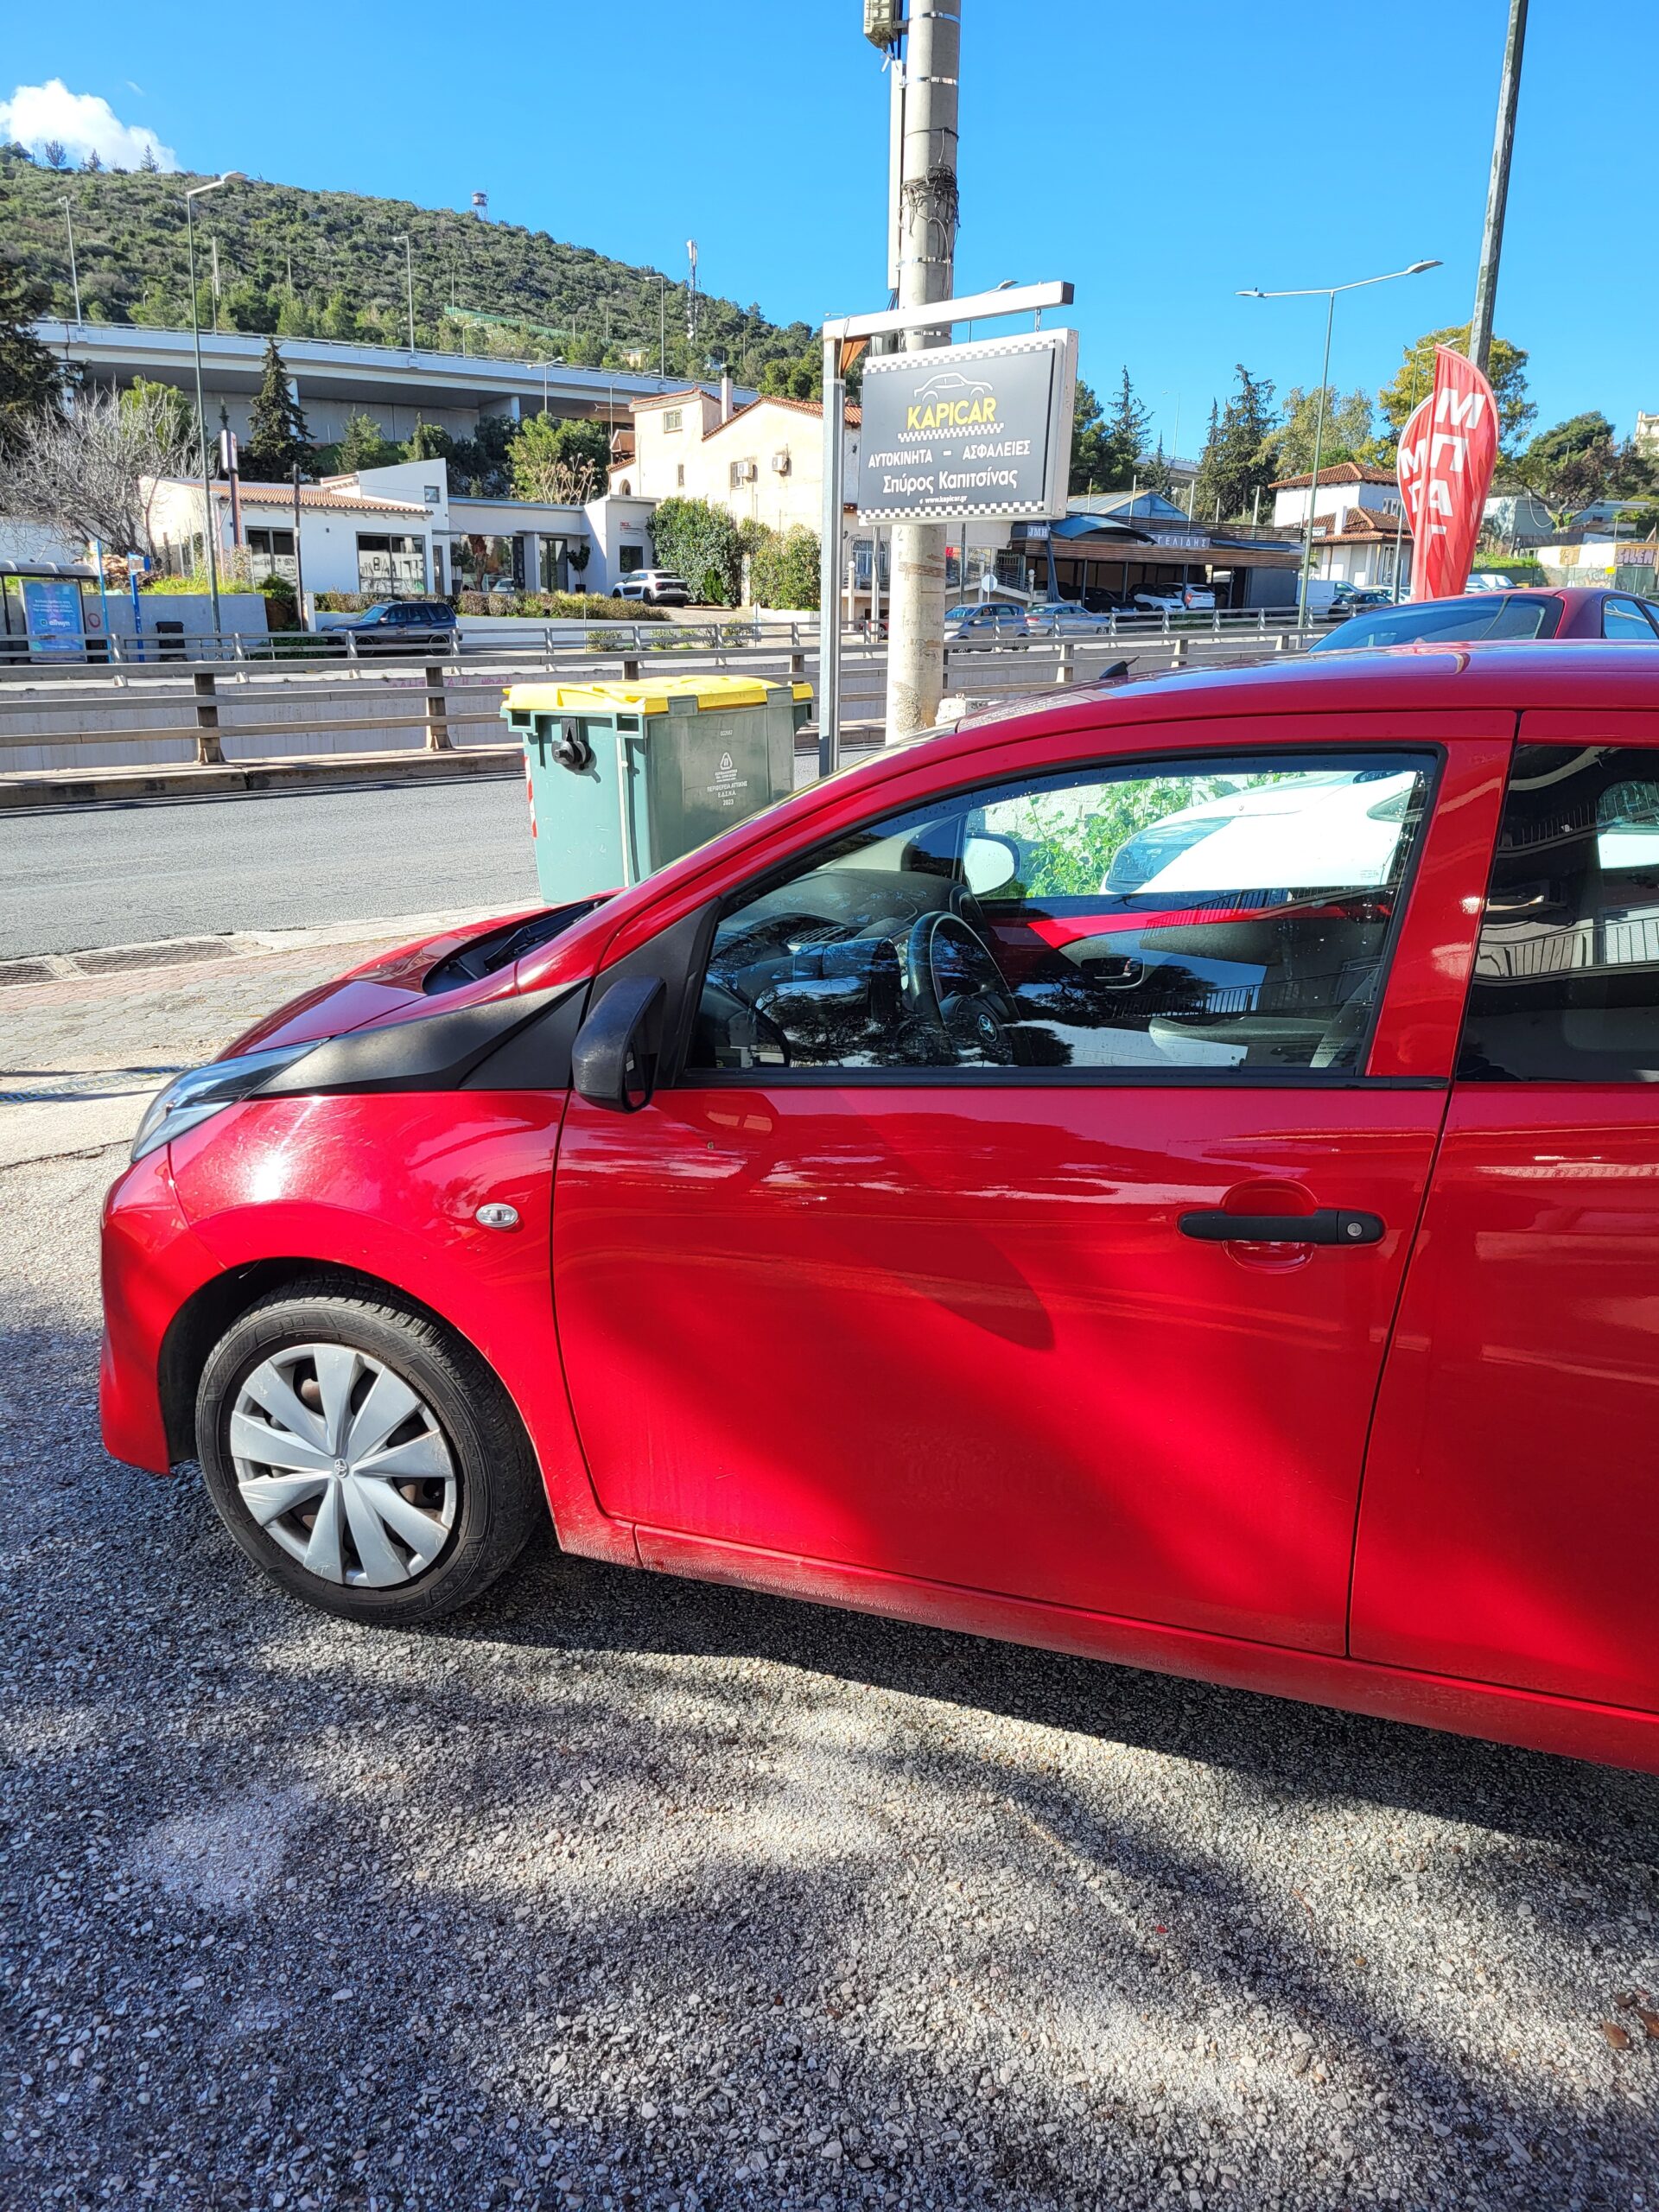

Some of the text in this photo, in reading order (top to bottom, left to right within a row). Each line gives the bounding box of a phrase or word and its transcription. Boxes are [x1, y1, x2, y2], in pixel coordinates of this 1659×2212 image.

[907, 397, 996, 430] KAPICAR
[868, 448, 933, 468] ΑΥΤΟΚΙΝΗΤΑ
[962, 439, 1031, 461] ΑΣΦΑΛΕΙΕΣ
[882, 466, 1019, 497] Σπύρος Καπιτσίνας
